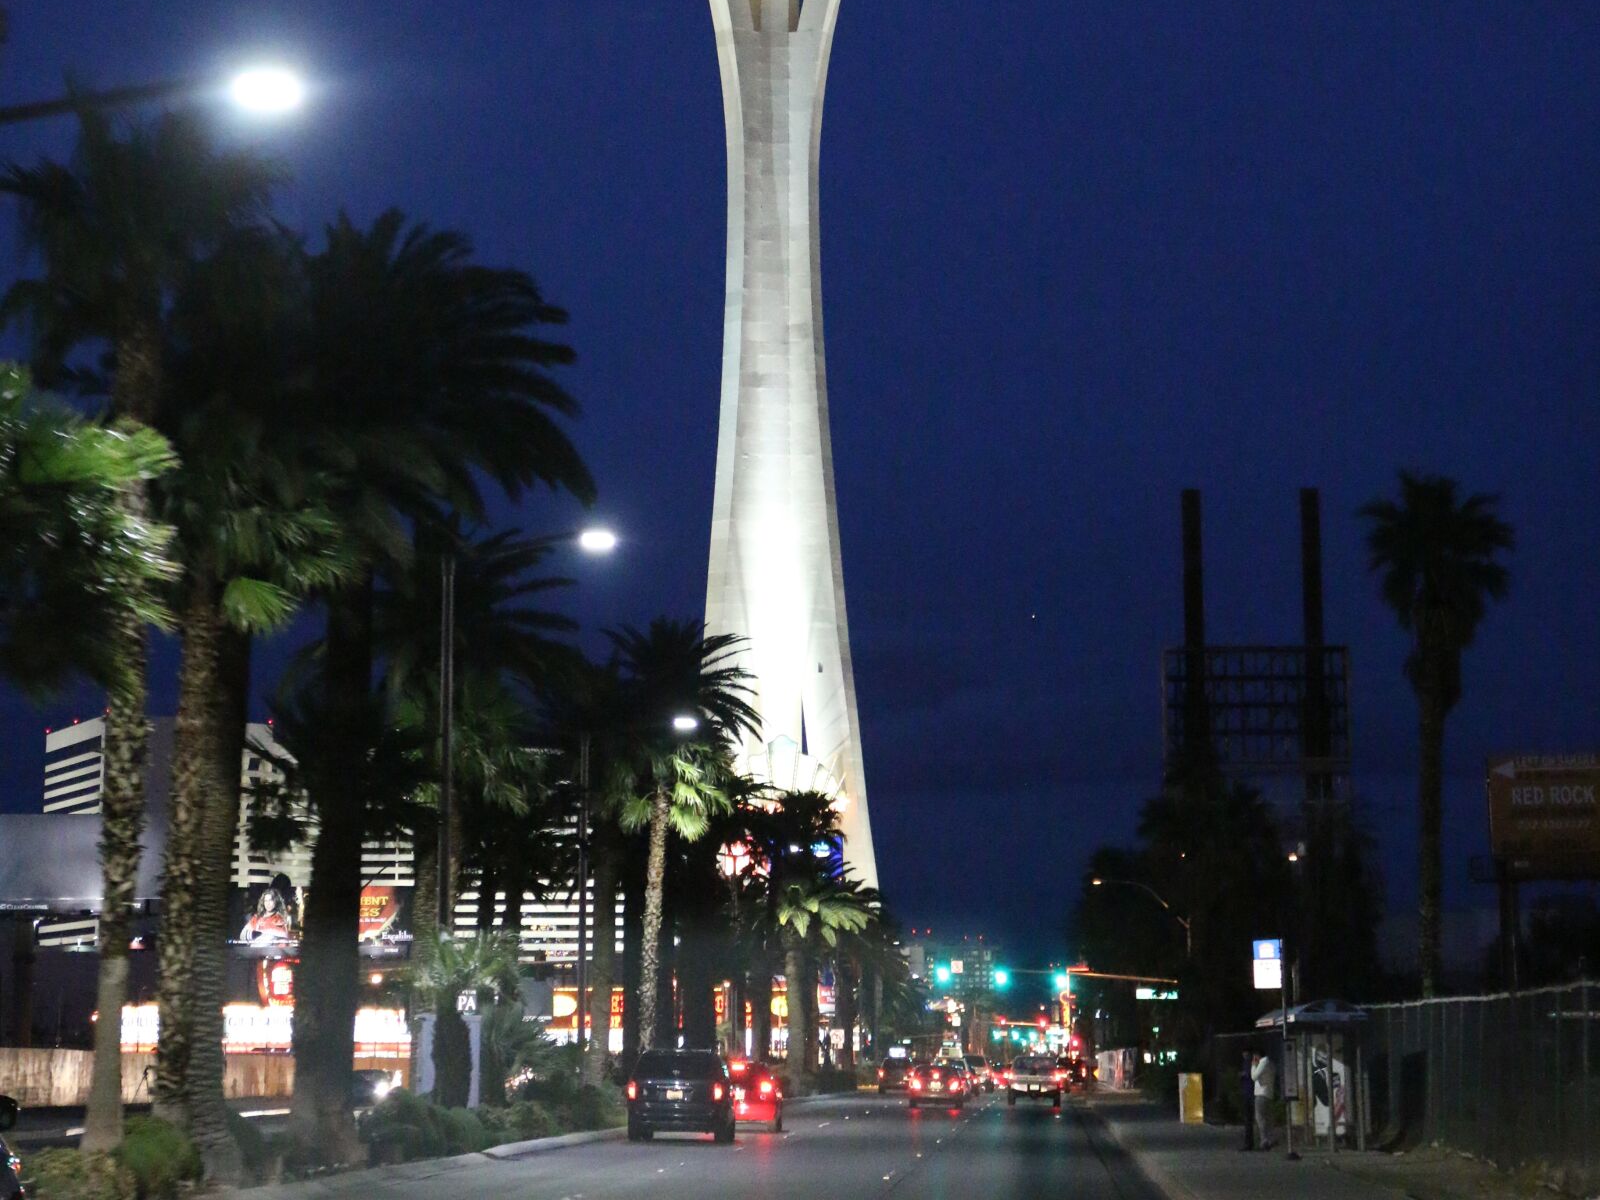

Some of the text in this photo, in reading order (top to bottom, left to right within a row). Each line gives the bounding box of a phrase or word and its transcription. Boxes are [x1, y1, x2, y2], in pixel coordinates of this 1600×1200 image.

[1511, 784, 1596, 805] RED ROCK
[381, 930, 414, 944] Excalibu
